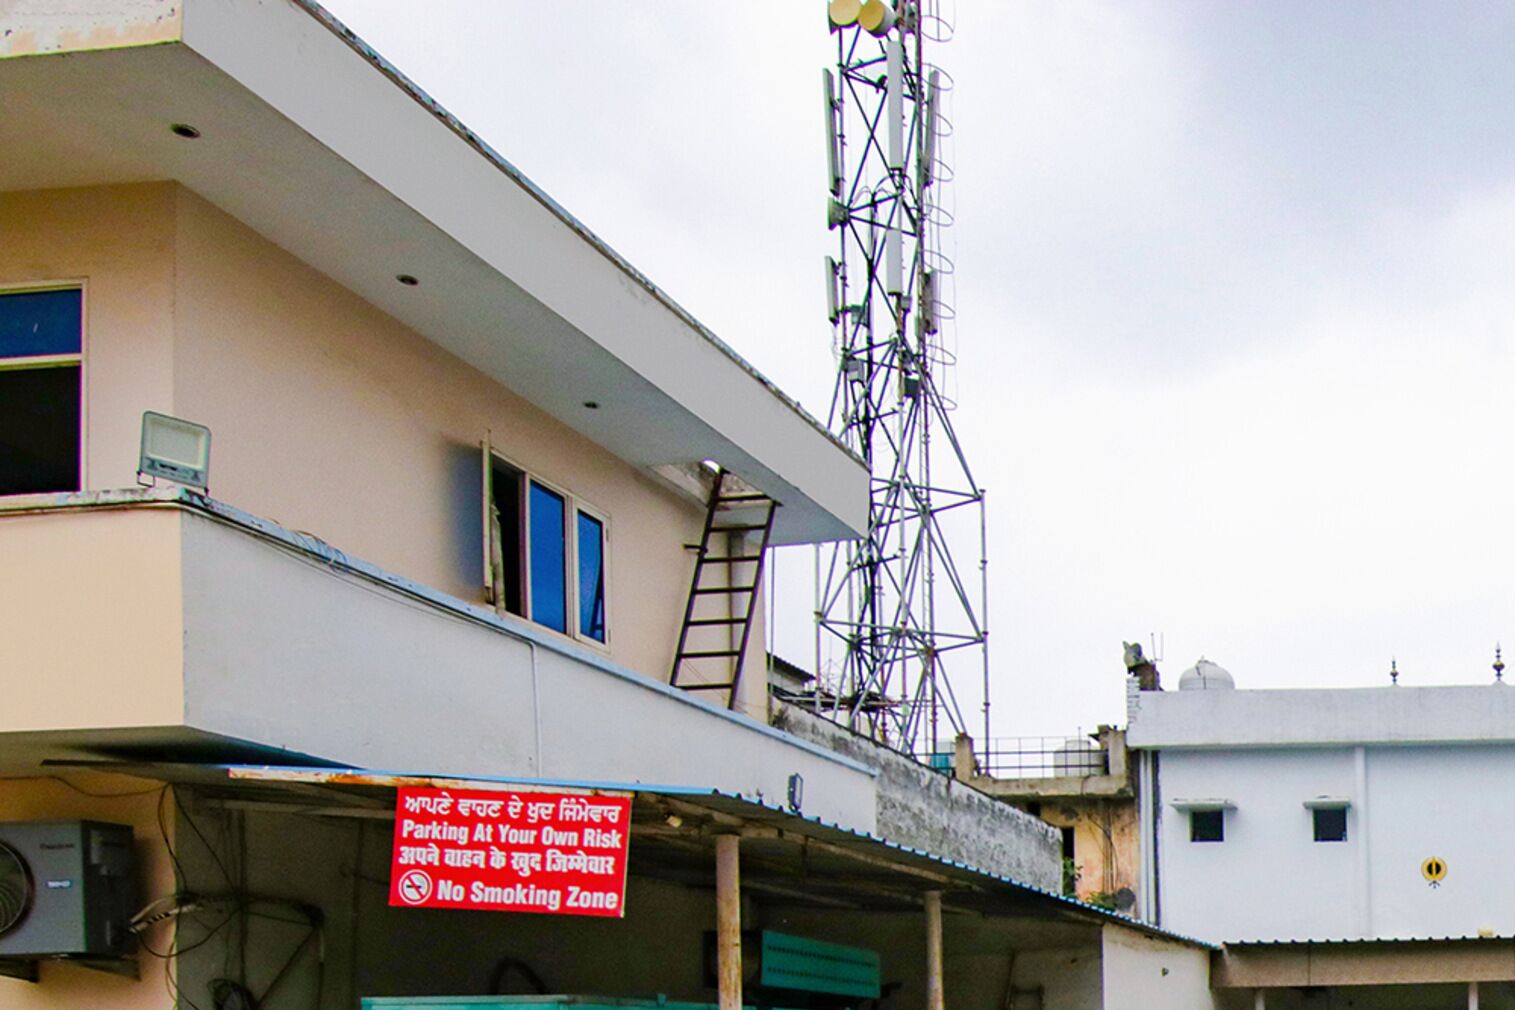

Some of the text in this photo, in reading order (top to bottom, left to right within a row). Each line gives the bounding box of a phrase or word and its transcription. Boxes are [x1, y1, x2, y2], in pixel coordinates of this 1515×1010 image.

[404, 791, 454, 815] ਆਪਣੇ
[507, 795, 523, 819] ਦੇ
[527, 802, 555, 823] ਖੁਦ
[402, 819, 622, 849] Parking At Your Own Risk
[398, 842, 440, 866] अपने
[444, 848, 486, 869] वाहन
[489, 845, 507, 870] के
[511, 851, 542, 877] खुद
[437, 879, 619, 911] No Smoking Zone
